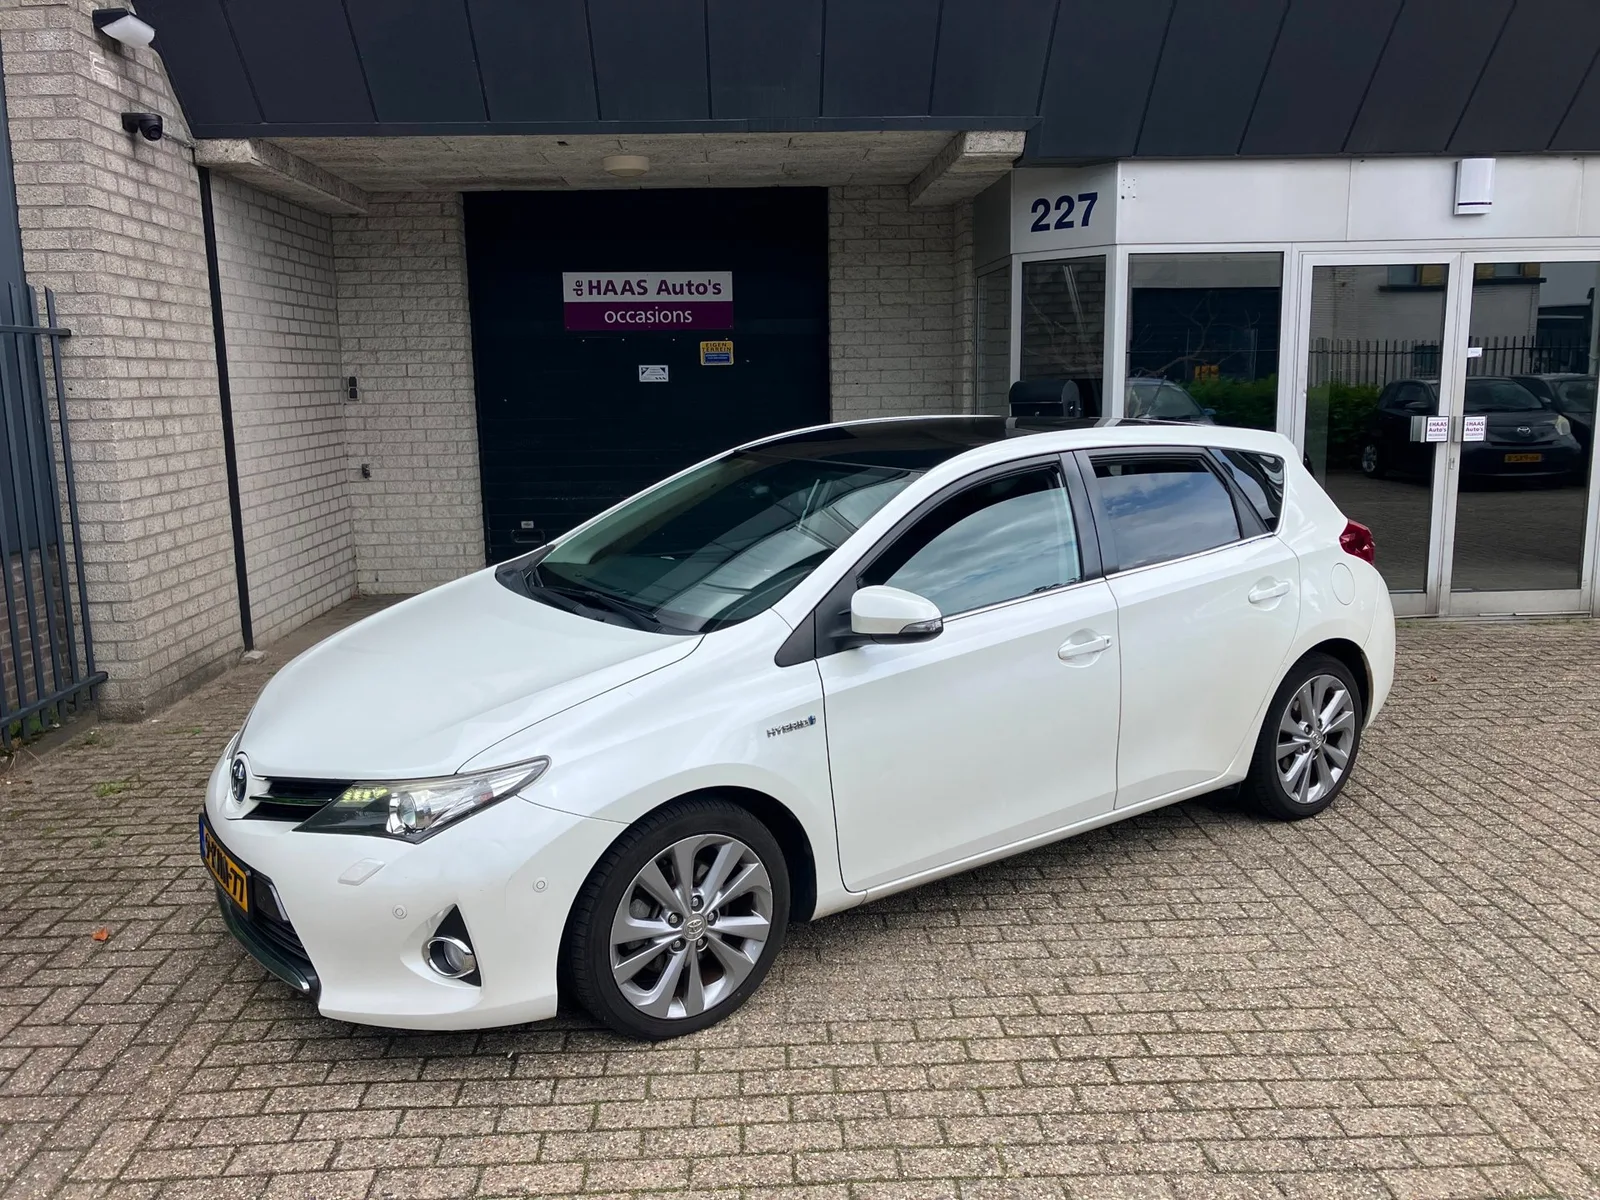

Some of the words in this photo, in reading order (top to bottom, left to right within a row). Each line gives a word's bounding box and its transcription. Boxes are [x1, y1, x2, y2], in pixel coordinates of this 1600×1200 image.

[1030, 191, 1098, 233] 227
[573, 280, 583, 296] de
[588, 279, 648, 296] HAAS
[656, 279, 722, 296] Auto's
[604, 306, 692, 323] occasions
